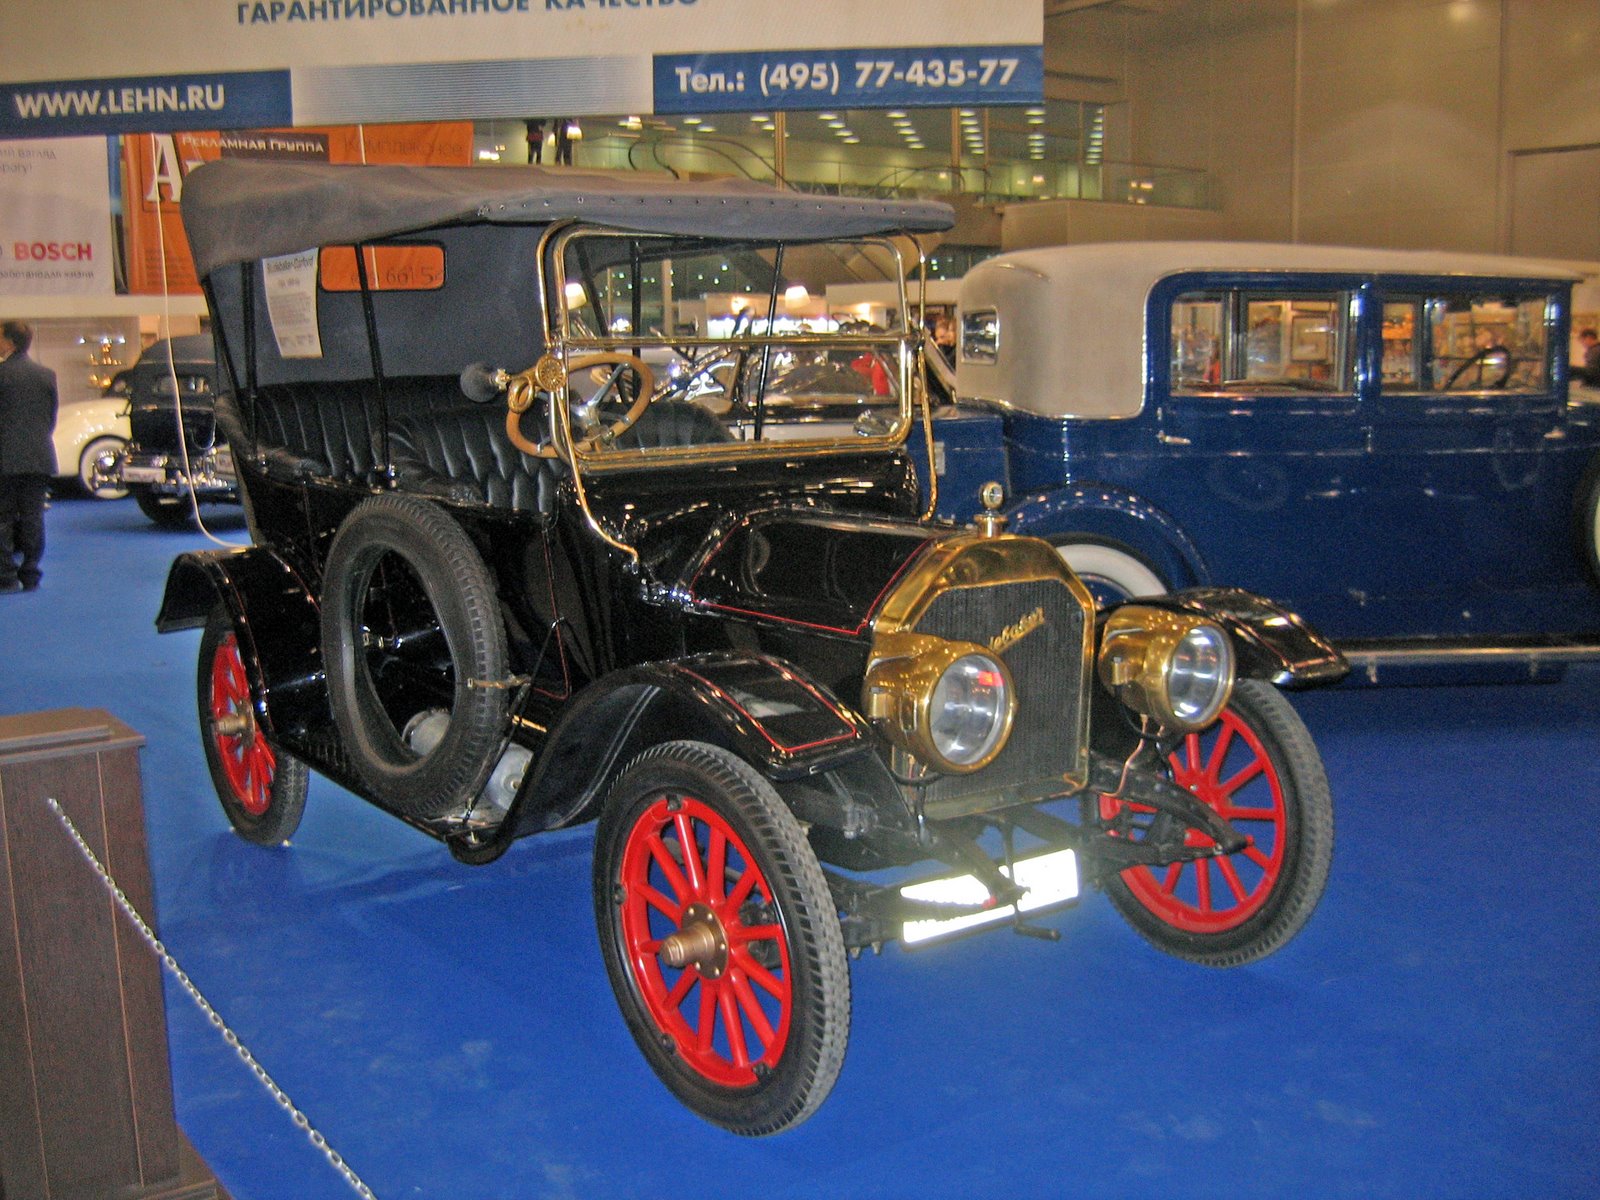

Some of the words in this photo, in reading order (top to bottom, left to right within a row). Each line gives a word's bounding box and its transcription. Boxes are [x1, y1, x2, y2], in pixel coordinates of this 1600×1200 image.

[237, 0, 529, 24] ГАРАНТИРОВАННОЕ
[675, 67, 745, 93] Тел.:
[760, 61, 840, 96] (495)
[855, 59, 1019, 88] 77-435-77
[15, 84, 225, 119] WWW.LEHN.RU
[15, 242, 92, 260] BOSCH
